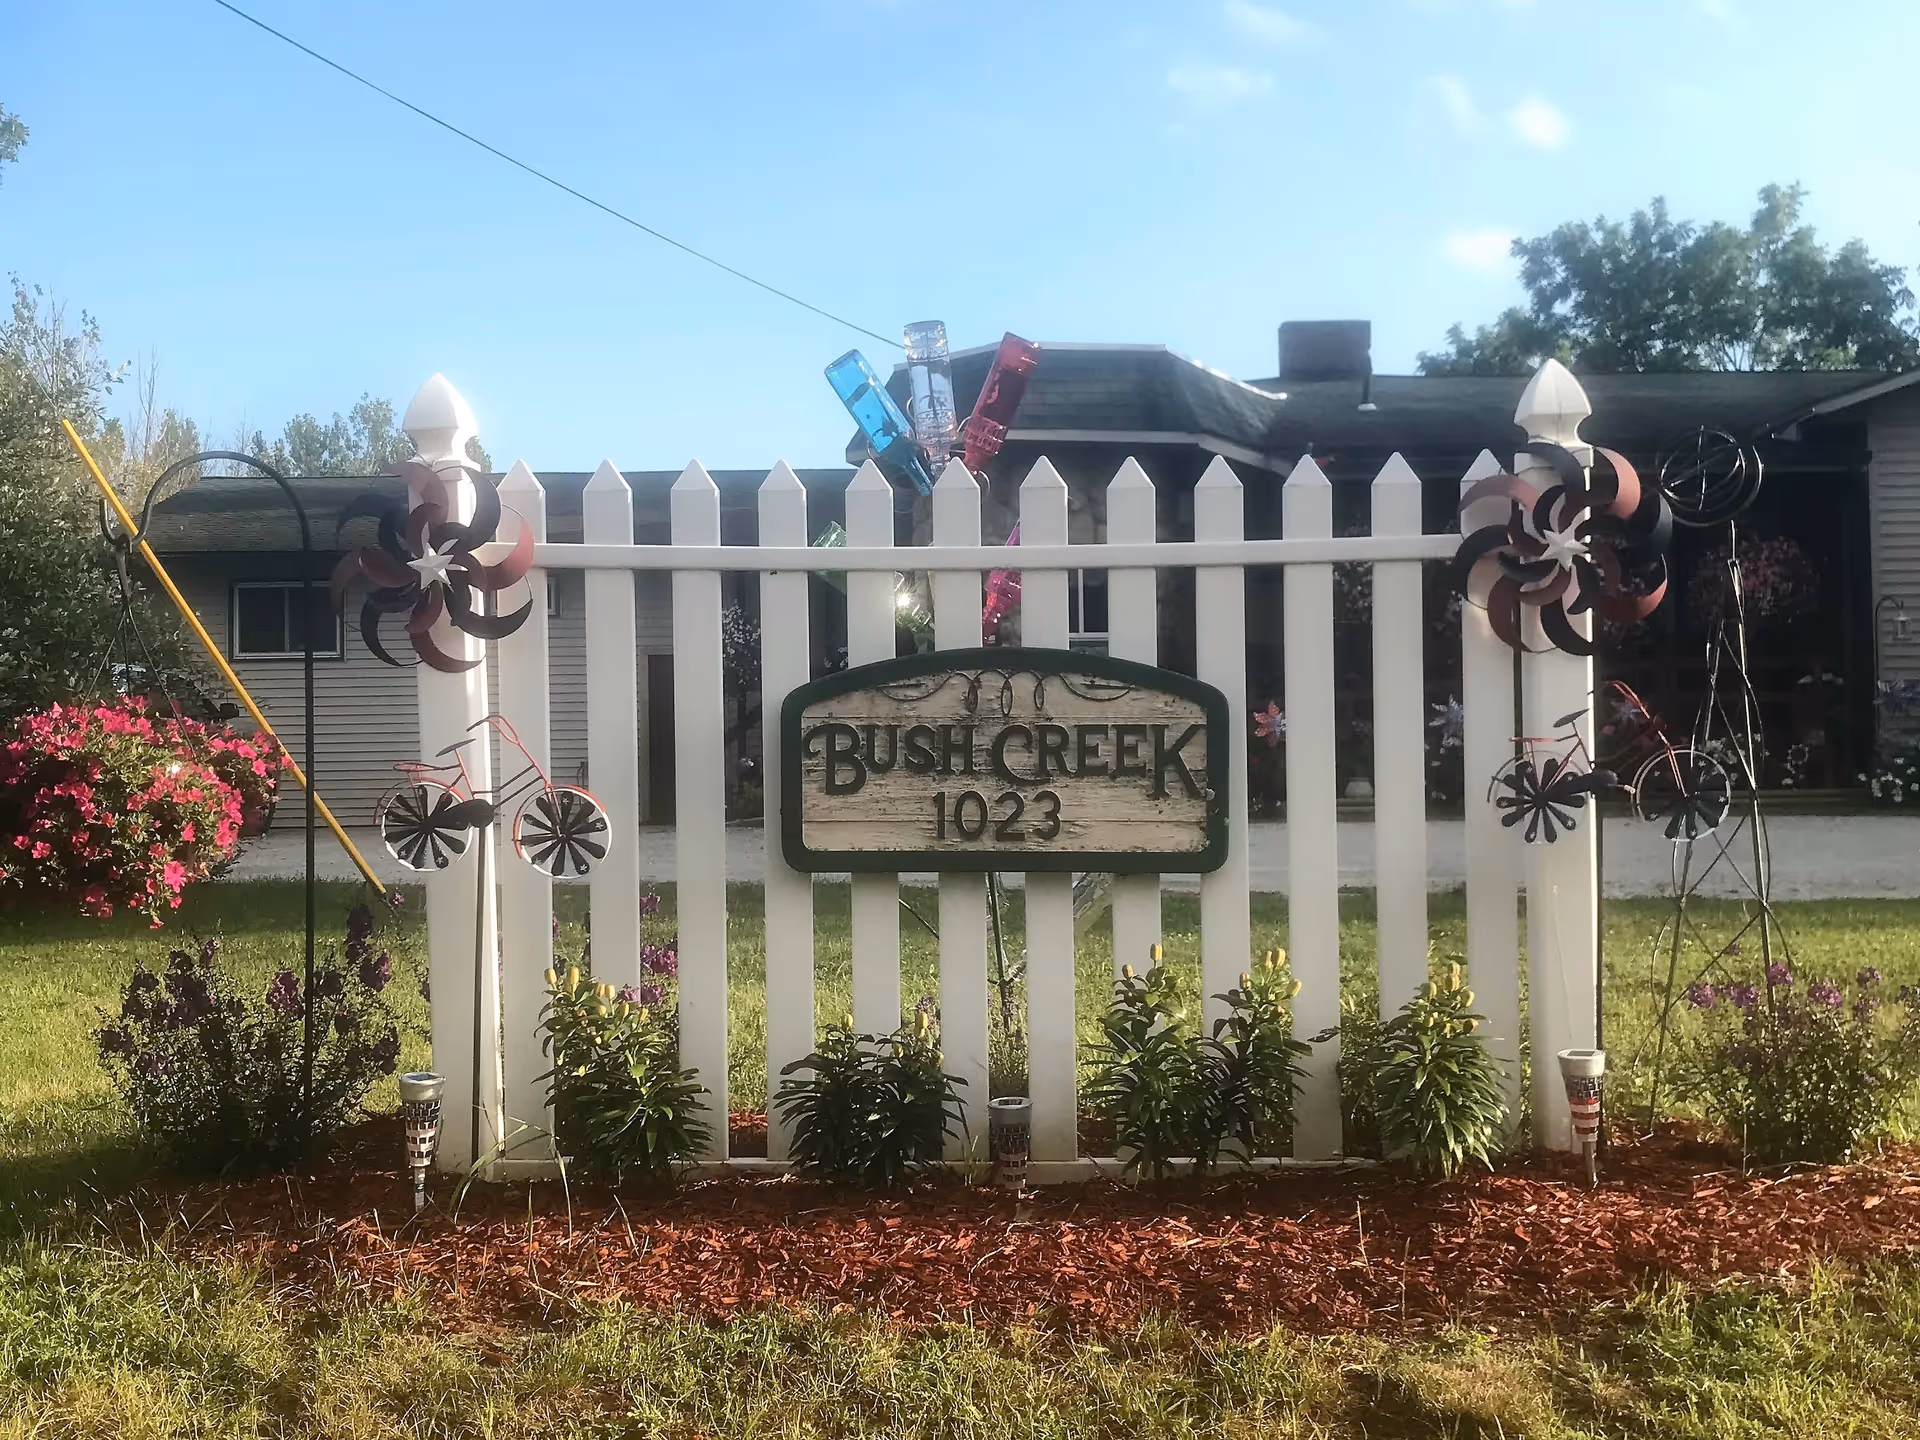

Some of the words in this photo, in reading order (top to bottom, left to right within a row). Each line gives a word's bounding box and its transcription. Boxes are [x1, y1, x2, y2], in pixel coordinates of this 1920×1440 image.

[803, 723, 978, 795] BUSH
[992, 723, 1206, 800] CREEK
[932, 790, 1063, 841] 1023
